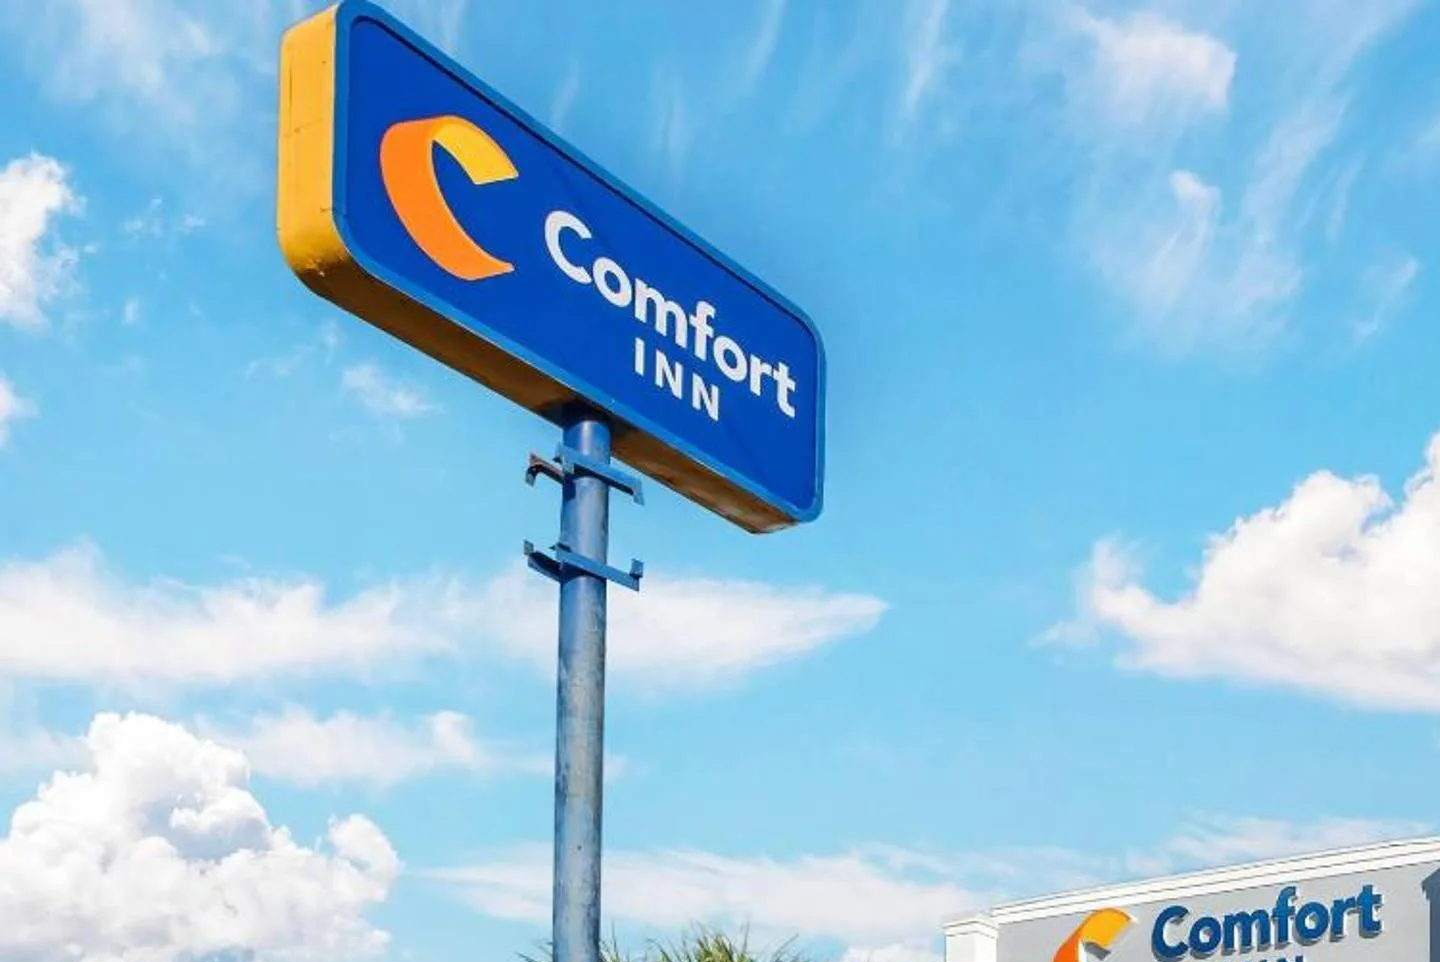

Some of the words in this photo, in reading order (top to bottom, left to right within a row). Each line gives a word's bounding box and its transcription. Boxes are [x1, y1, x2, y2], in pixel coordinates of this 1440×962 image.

[544, 210, 796, 418] Comfort
[634, 337, 719, 421] INN
[1151, 884, 1382, 960] Comfort
